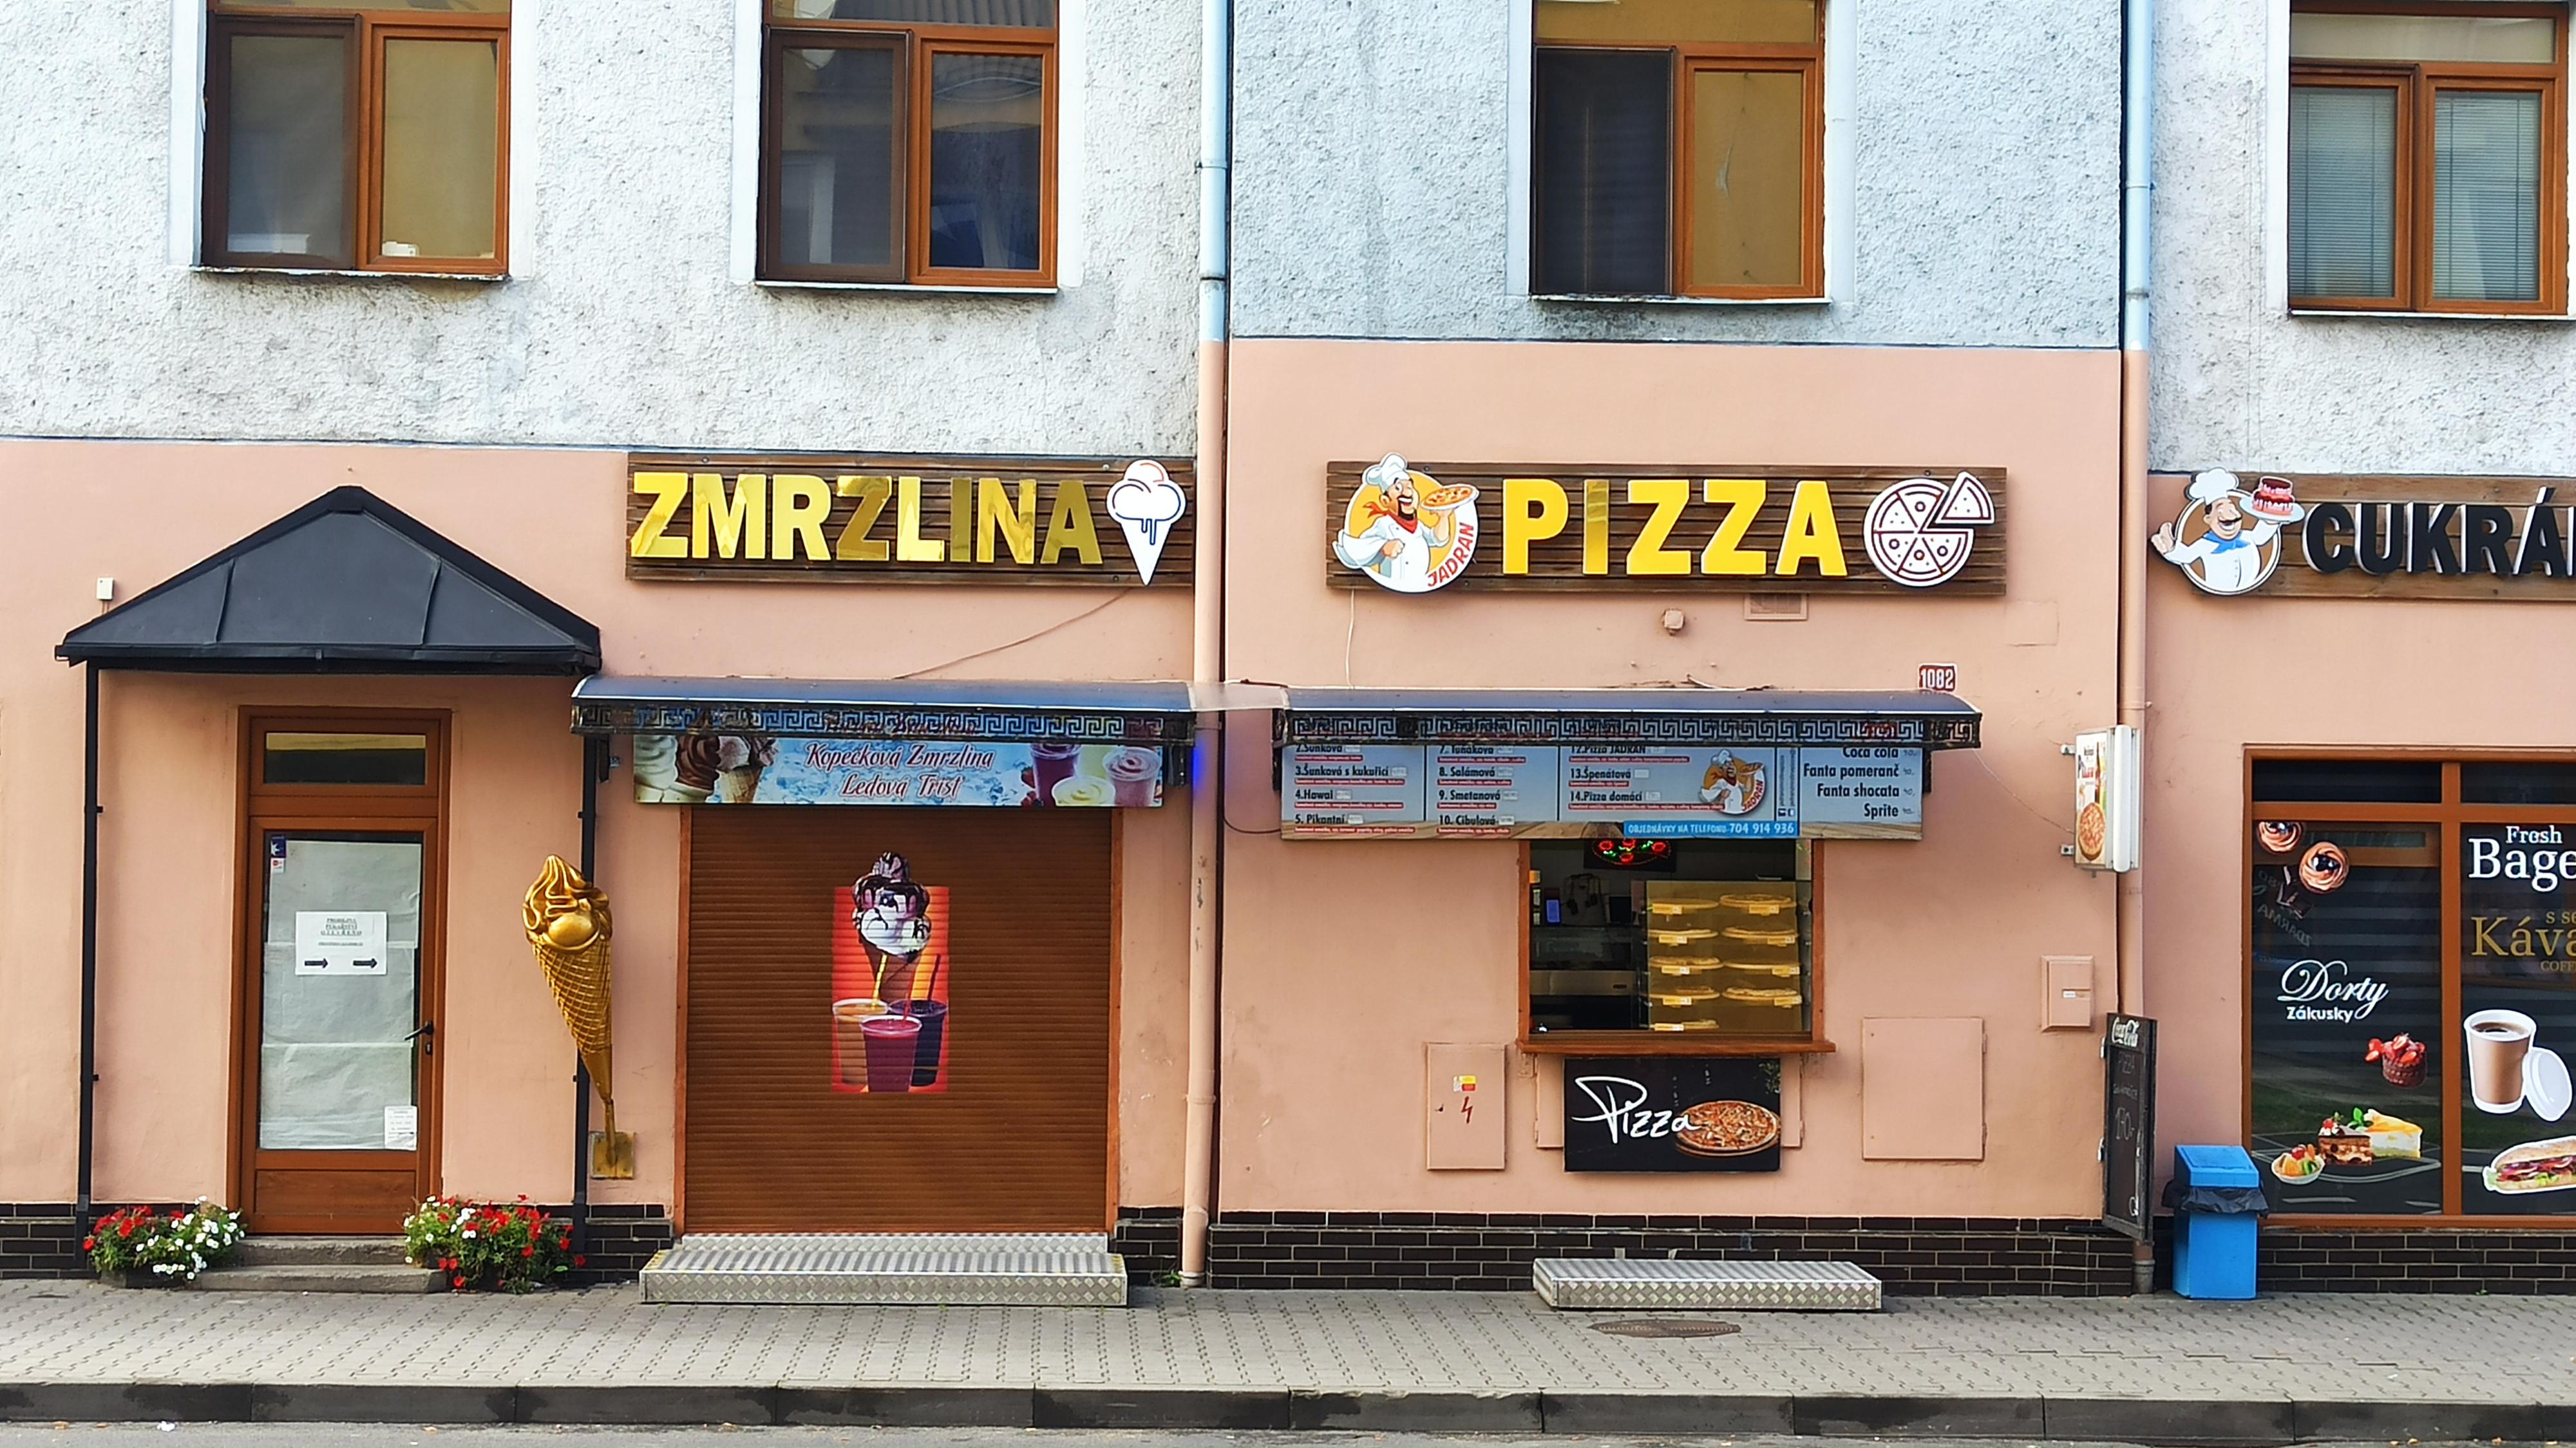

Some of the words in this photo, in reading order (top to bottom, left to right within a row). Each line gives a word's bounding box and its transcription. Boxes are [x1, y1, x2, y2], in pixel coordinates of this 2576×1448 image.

[630, 471, 1103, 565] ZMRZLINA
[1502, 478, 1848, 576] PIZZA
[2302, 486, 2576, 576] CUKRÁ
[1427, 522, 1475, 587] JADRAN
[1920, 669, 1954, 690] 1082
[906, 743, 996, 771] Zmrzlina
[1842, 748, 1870, 758] Coca
[1874, 748, 1899, 758] cola
[1450, 766, 1495, 777] Salámová
[1803, 762, 1836, 777] Fanta
[1840, 762, 1899, 780] pomeranč
[841, 773, 910, 798] Ledová
[1450, 789, 1501, 800] Smetanová
[1817, 783, 1850, 797] Fanta
[1853, 782, 1899, 797] shocata
[1864, 803, 1899, 820] Sprite
[1628, 823, 1676, 834] OBJEDNÁVKY
[1678, 824, 1689, 833] NA
[1729, 823, 1749, 834] 704
[1752, 823, 1770, 834] 914
[1774, 823, 1795, 834] 936
[2505, 825, 2563, 844] Fresh
[2468, 838, 2576, 892] Bage
[2546, 911, 2555, 924] s
[2277, 959, 2389, 1020] Dorty
[2287, 1005, 2354, 1023] Zákusky
[1570, 1076, 1702, 1145] Pizza
